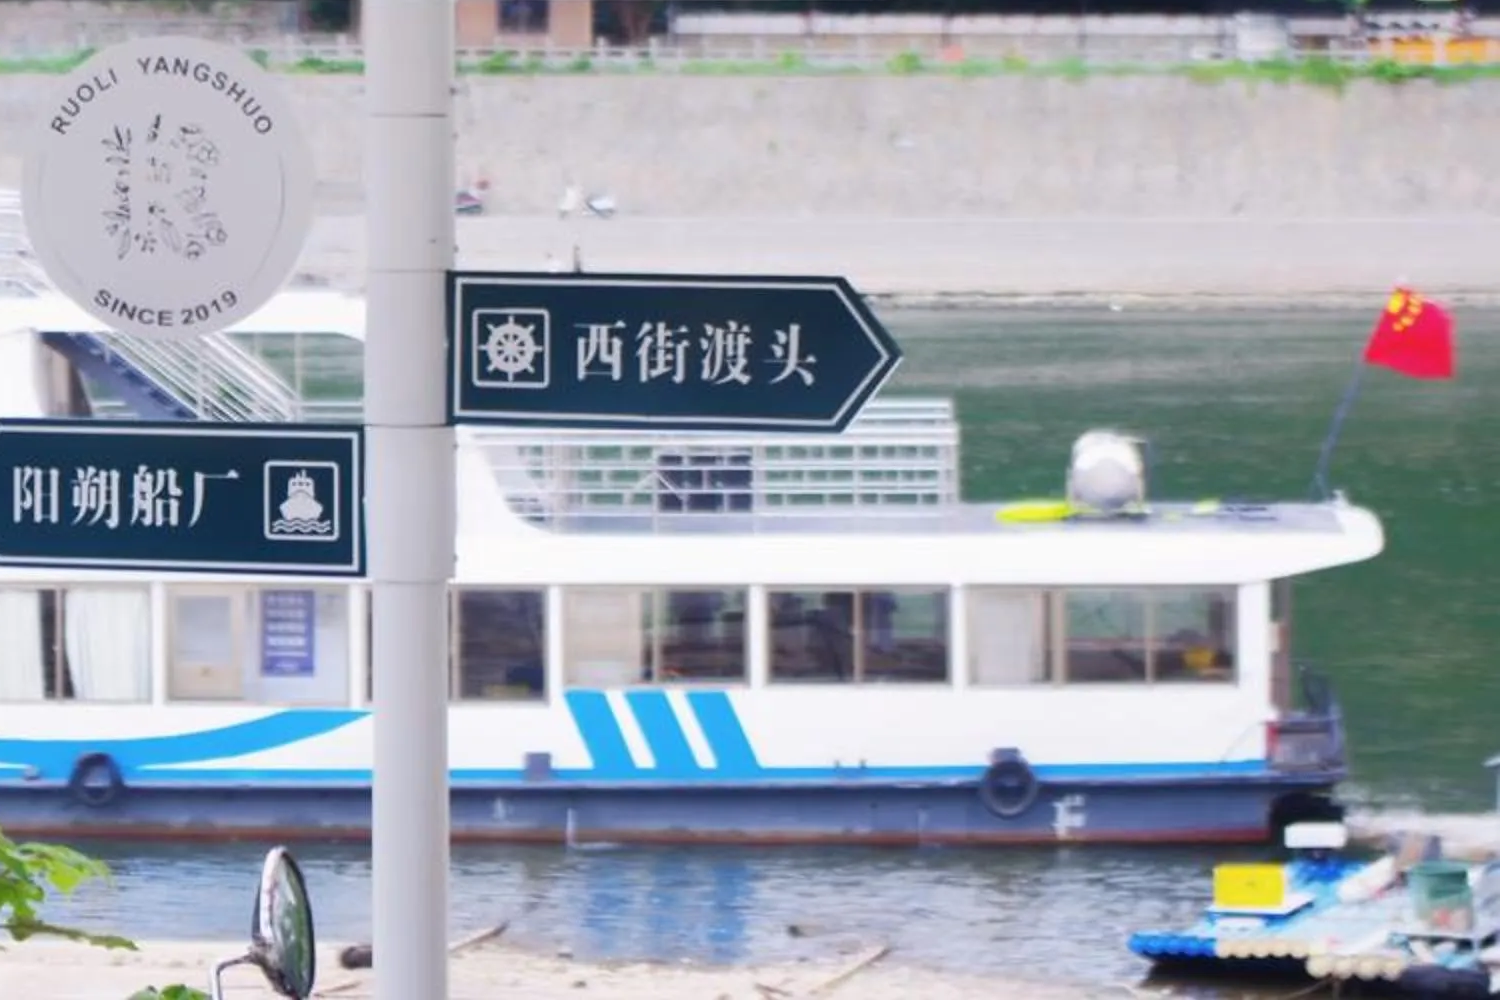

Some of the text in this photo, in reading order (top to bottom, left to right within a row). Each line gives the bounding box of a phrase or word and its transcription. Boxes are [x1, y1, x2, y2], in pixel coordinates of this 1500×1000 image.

[51, 55, 274, 136] RUOLI YANGSHUO
[93, 288, 239, 327] SINCE 2019
[575, 319, 817, 387] 西街渡头
[12, 463, 240, 530] 阳朔船厂
